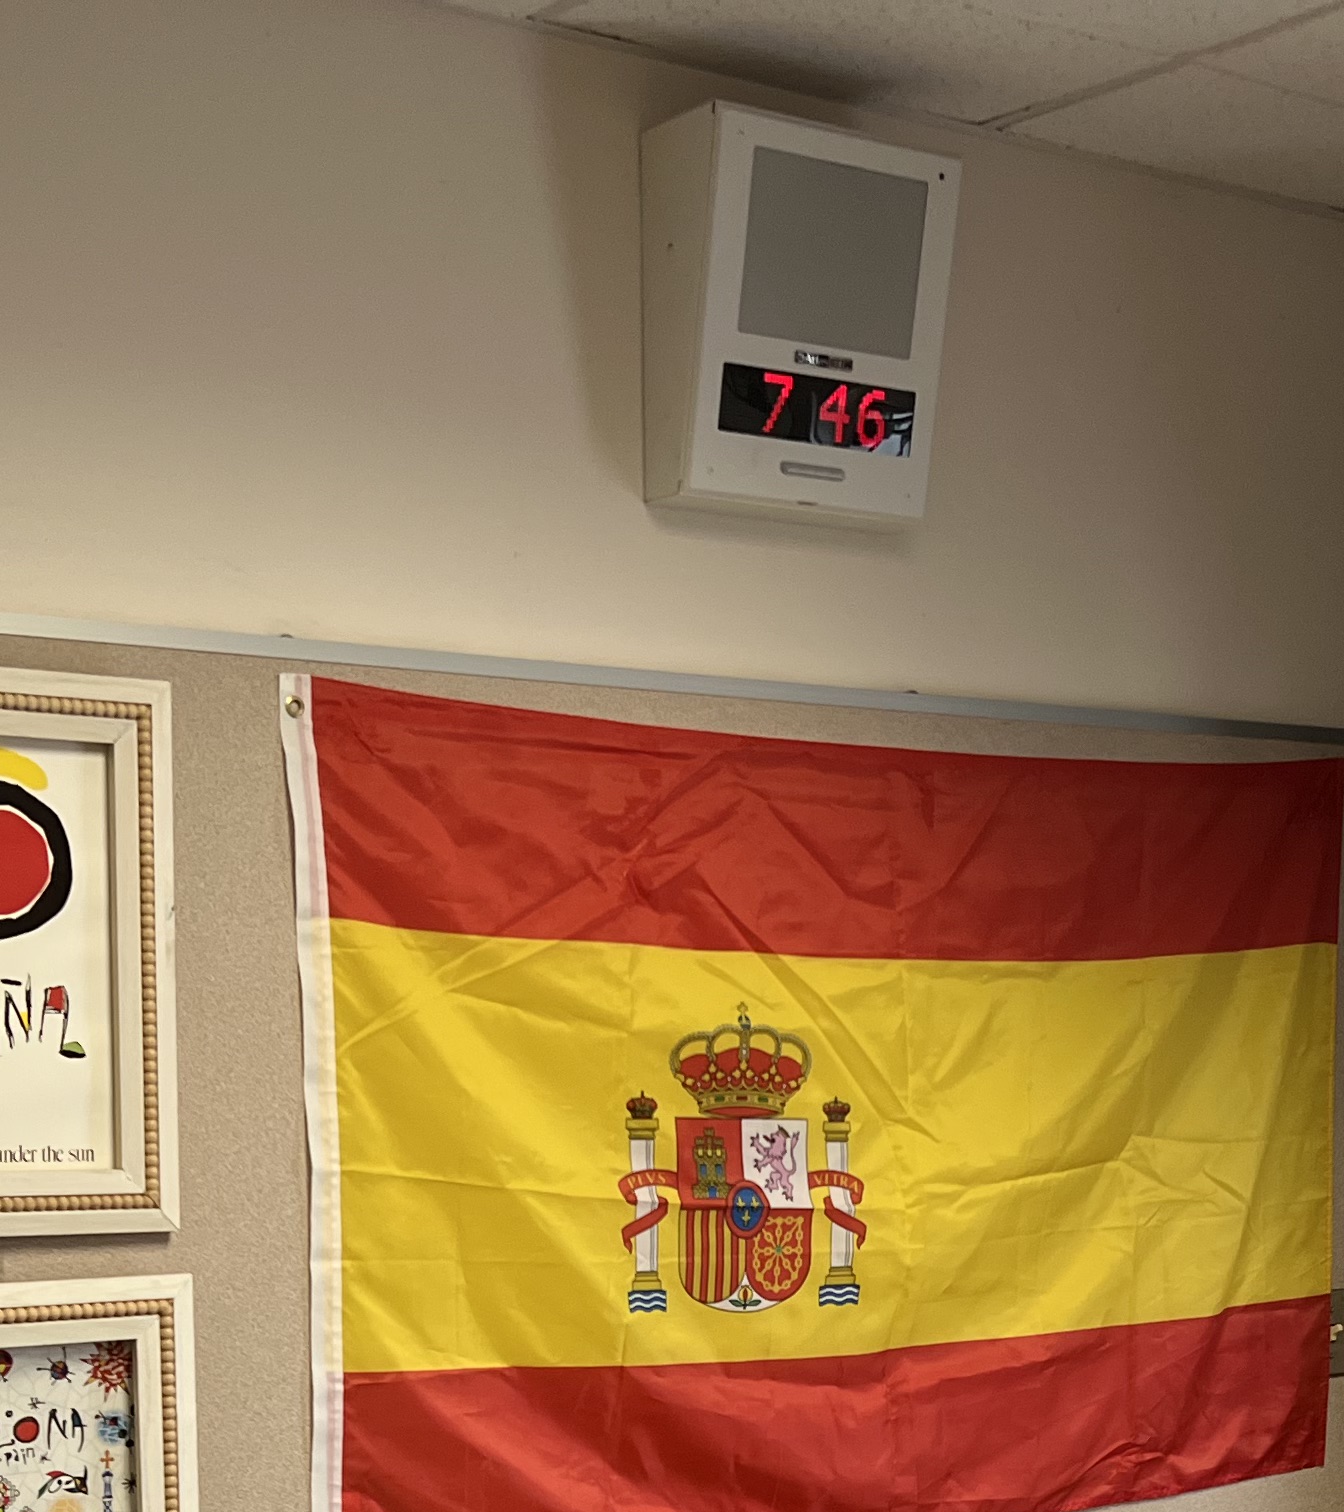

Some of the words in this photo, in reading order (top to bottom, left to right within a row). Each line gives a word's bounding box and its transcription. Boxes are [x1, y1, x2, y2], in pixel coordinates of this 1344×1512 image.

[819, 384, 886, 449] 46
[42, 1145, 64, 1164] the
[68, 1147, 95, 1164] sun
